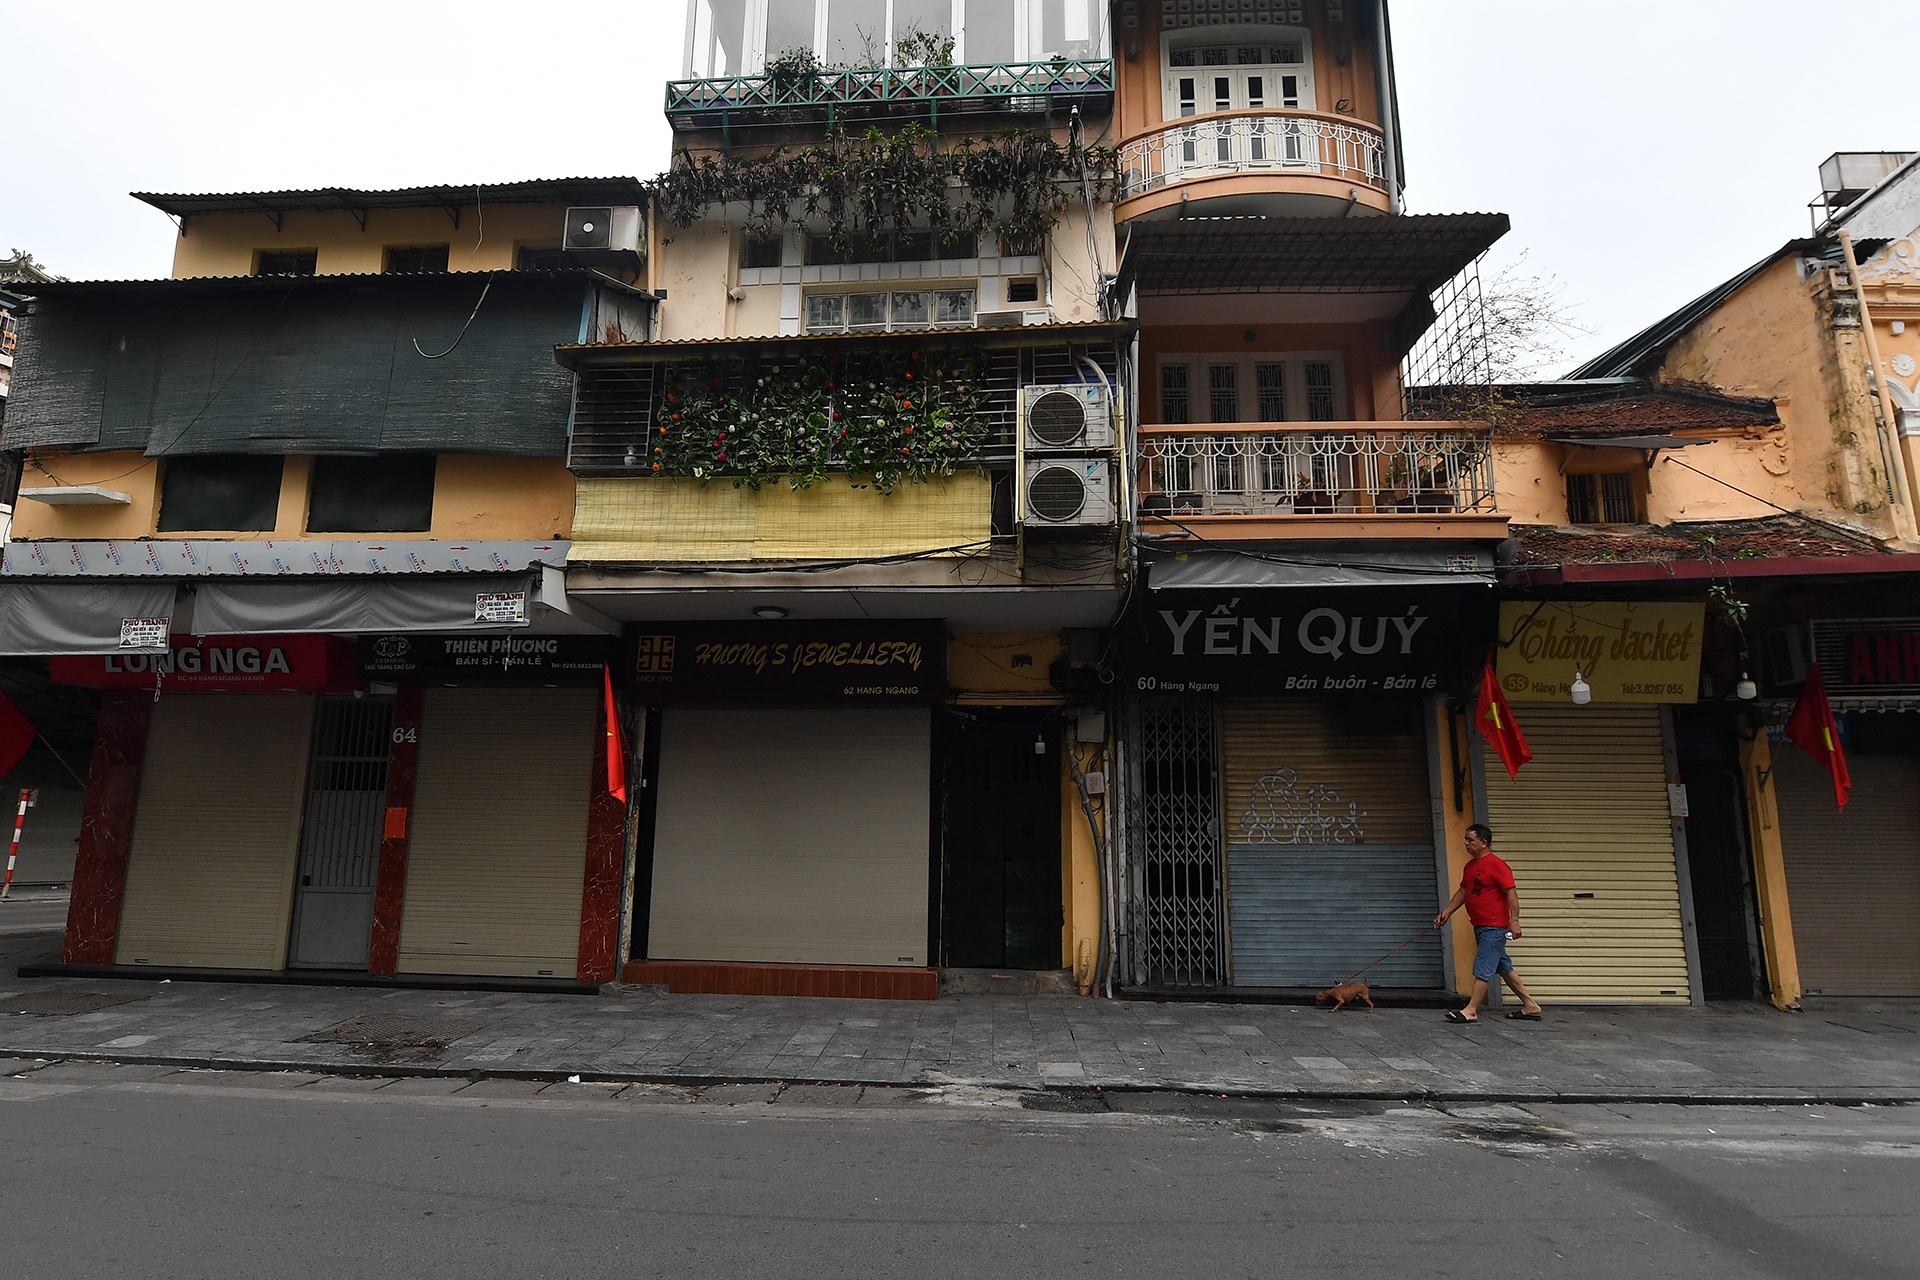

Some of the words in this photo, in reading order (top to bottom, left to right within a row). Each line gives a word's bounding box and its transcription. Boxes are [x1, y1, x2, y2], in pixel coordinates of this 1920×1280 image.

[33, 542, 45, 565] ALUTITA
[107, 541, 120, 565] ALUTITA
[182, 541, 196, 565] ALUTITA
[233, 552, 246, 574] ALUTIT
[312, 552, 325, 574] ALUTIT
[1158, 598, 1282, 655] YẾN
[1297, 606, 1429, 661] QUÝ
[444, 637, 489, 653] THIÊN
[491, 639, 558, 654] PHƯƠNG
[1610, 618, 1694, 662] Jacket
[104, 647, 202, 674] LONG
[210, 647, 291, 674] NGA
[456, 656, 479, 666] BÁN
[792, 641, 923, 675] JEWELLERY
[843, 687, 854, 695] 62
[857, 687, 883, 695] HANG
[885, 687, 919, 695] NGANG
[1137, 677, 1156, 690] 60
[1160, 680, 1185, 692] Hàng
[1188, 681, 1219, 692] Ngang
[1285, 676, 1318, 690] Bán
[1323, 675, 1367, 690] buôn
[1383, 676, 1417, 690] Bán
[1508, 677, 1525, 690] 58
[1532, 681, 1556, 696] Hàng
[1667, 684, 1684, 695] 055
[392, 727, 417, 743] 64
